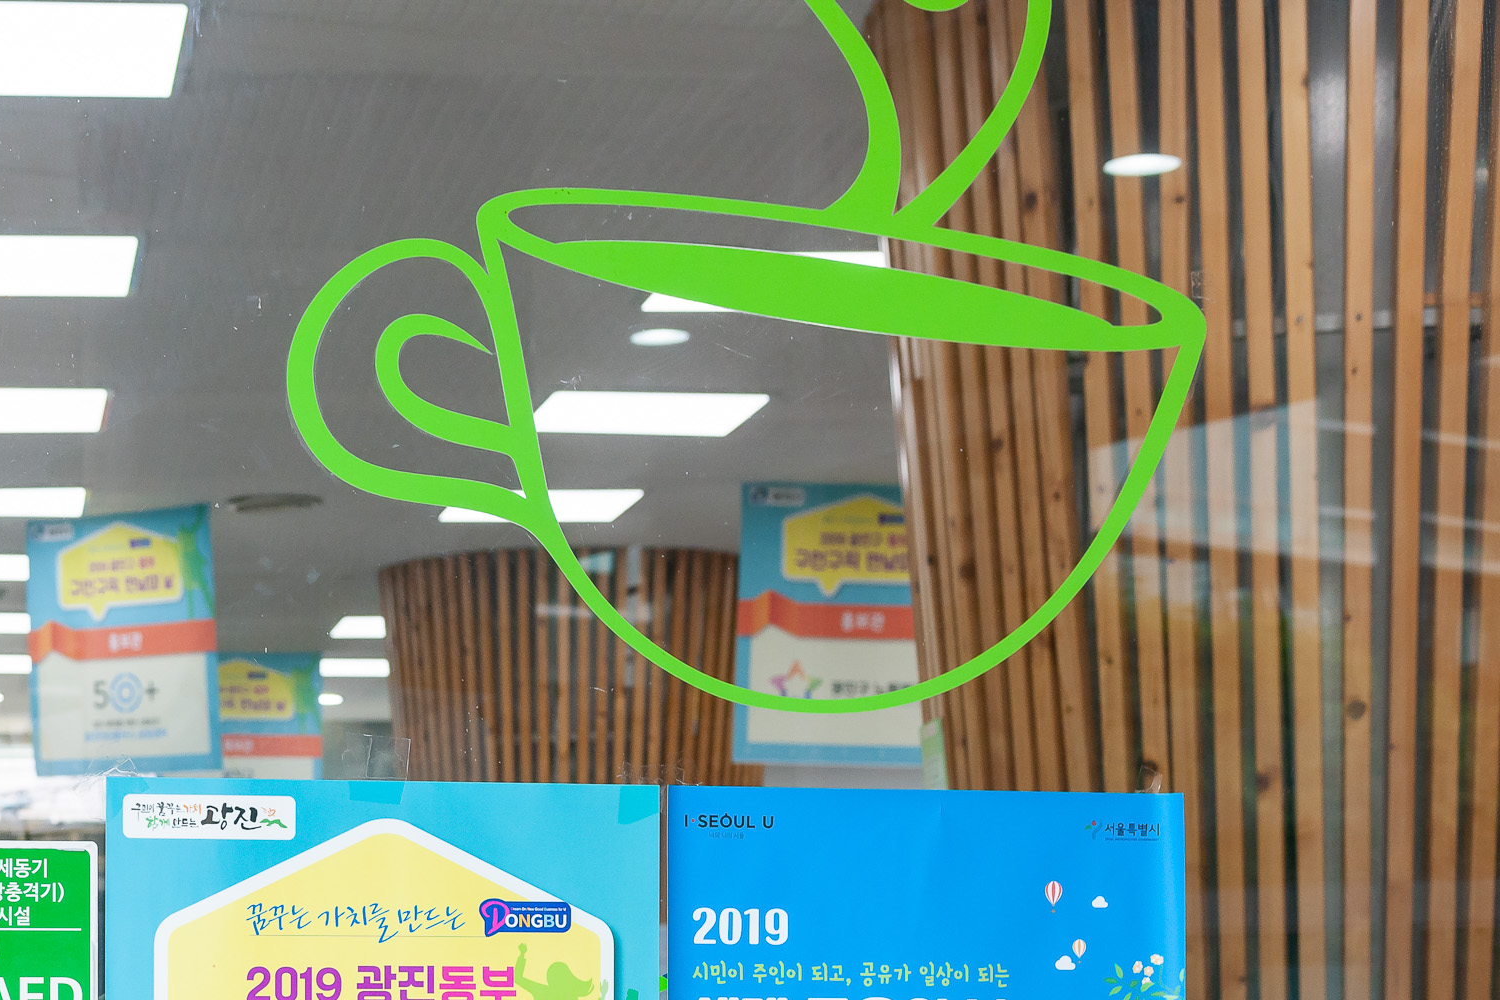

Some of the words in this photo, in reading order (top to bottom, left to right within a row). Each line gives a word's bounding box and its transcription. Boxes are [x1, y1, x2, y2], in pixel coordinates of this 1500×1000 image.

[201, 802, 262, 831] 광진
[698, 812, 756, 829] SEOUL
[762, 815, 774, 829] U
[1104, 822, 1160, 837] 서울특별시
[246, 902, 314, 936] 꿈꾸는
[318, 904, 397, 943] 가치를
[397, 904, 468, 934] 만드는
[481, 900, 567, 934] DONGBU
[692, 907, 788, 946] 2019
[692, 962, 744, 985] 시민이
[752, 961, 803, 986] 주인이
[811, 963, 851, 987] 되고,
[860, 961, 911, 986] 공유가
[919, 961, 970, 987] 일상이
[978, 962, 1011, 988] 되는
